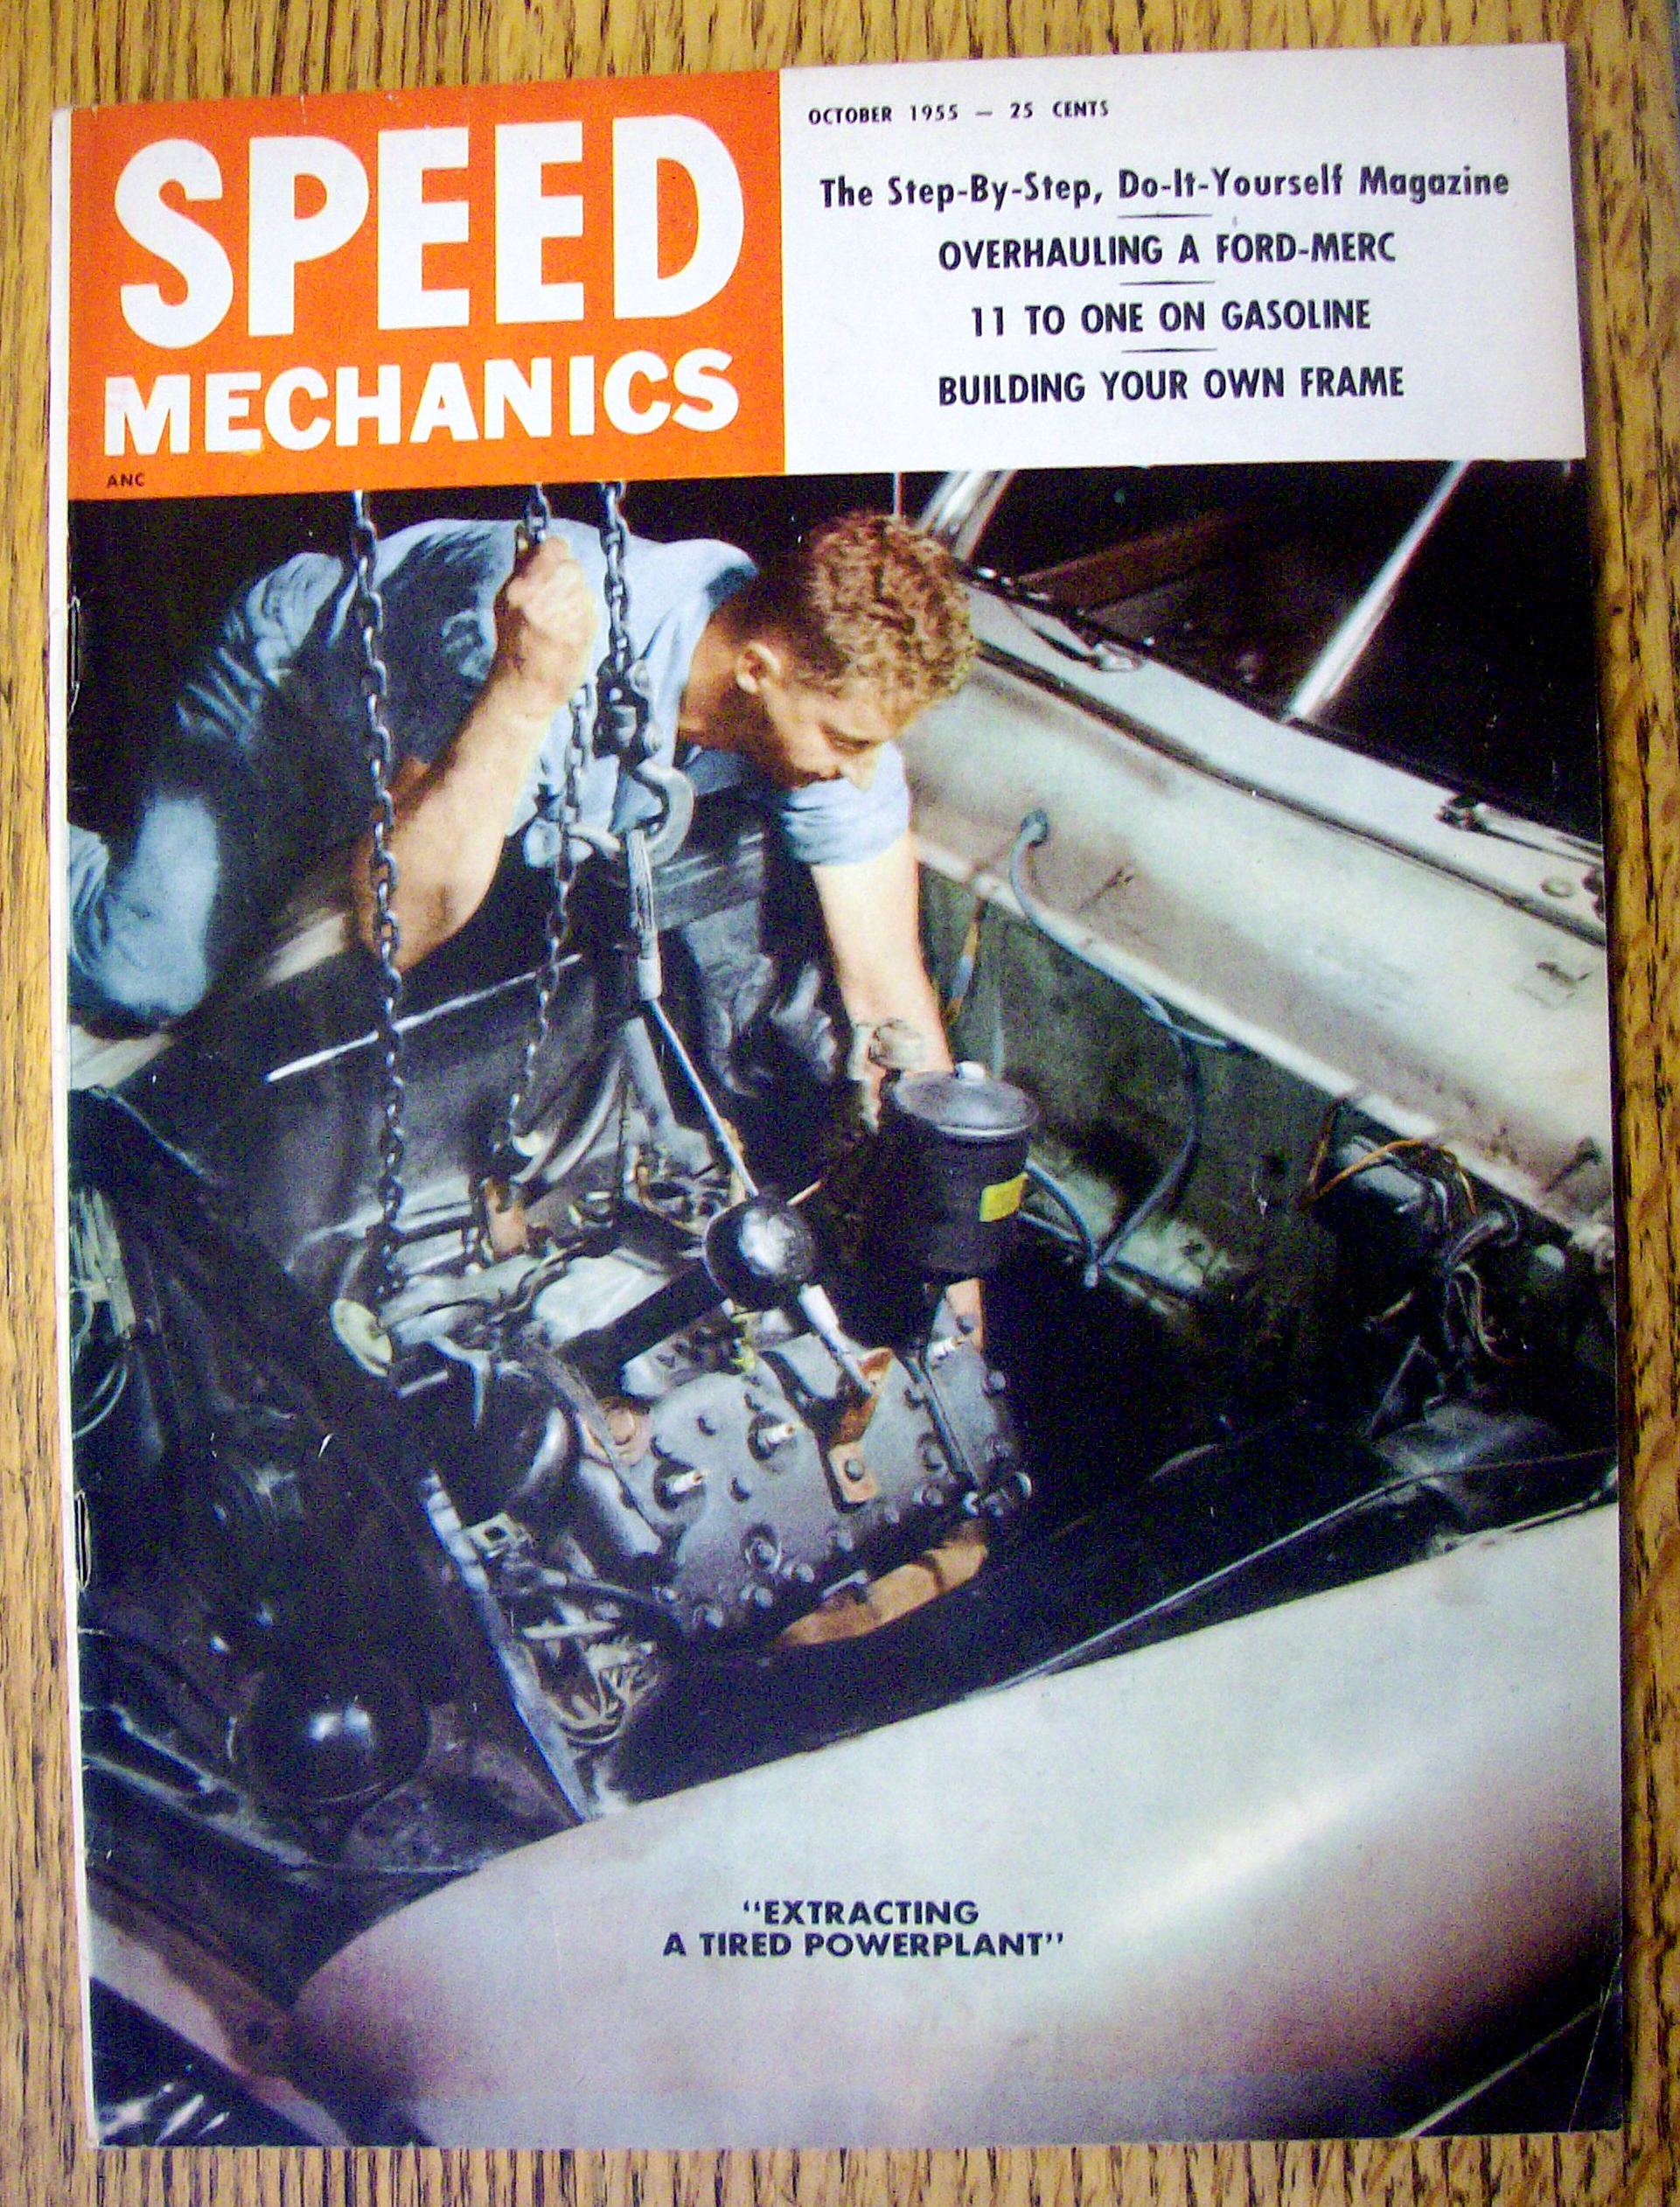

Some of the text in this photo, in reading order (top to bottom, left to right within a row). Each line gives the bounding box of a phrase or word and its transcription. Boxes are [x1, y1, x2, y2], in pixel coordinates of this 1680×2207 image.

[808, 106, 892, 125] OCTOBER
[911, 104, 959, 122] 1955
[1010, 101, 1034, 119] 25
[1052, 100, 1109, 117] CENTS
[819, 163, 1509, 211] The Step-By-Step, Do-It-Yourself Magazine
[115, 115, 744, 348] SPEED
[938, 231, 1396, 271] OVERHAULING A FORD-MERC
[972, 298, 1370, 337] 11 TO ONE ON GASOLINE
[105, 349, 739, 456] MECHANICS
[938, 366, 1405, 406] BUILDING YOUR OWN FRAME
[107, 472, 144, 488] ANC
[663, 1931, 687, 1957] A
[699, 1932, 792, 1957] TIRED
